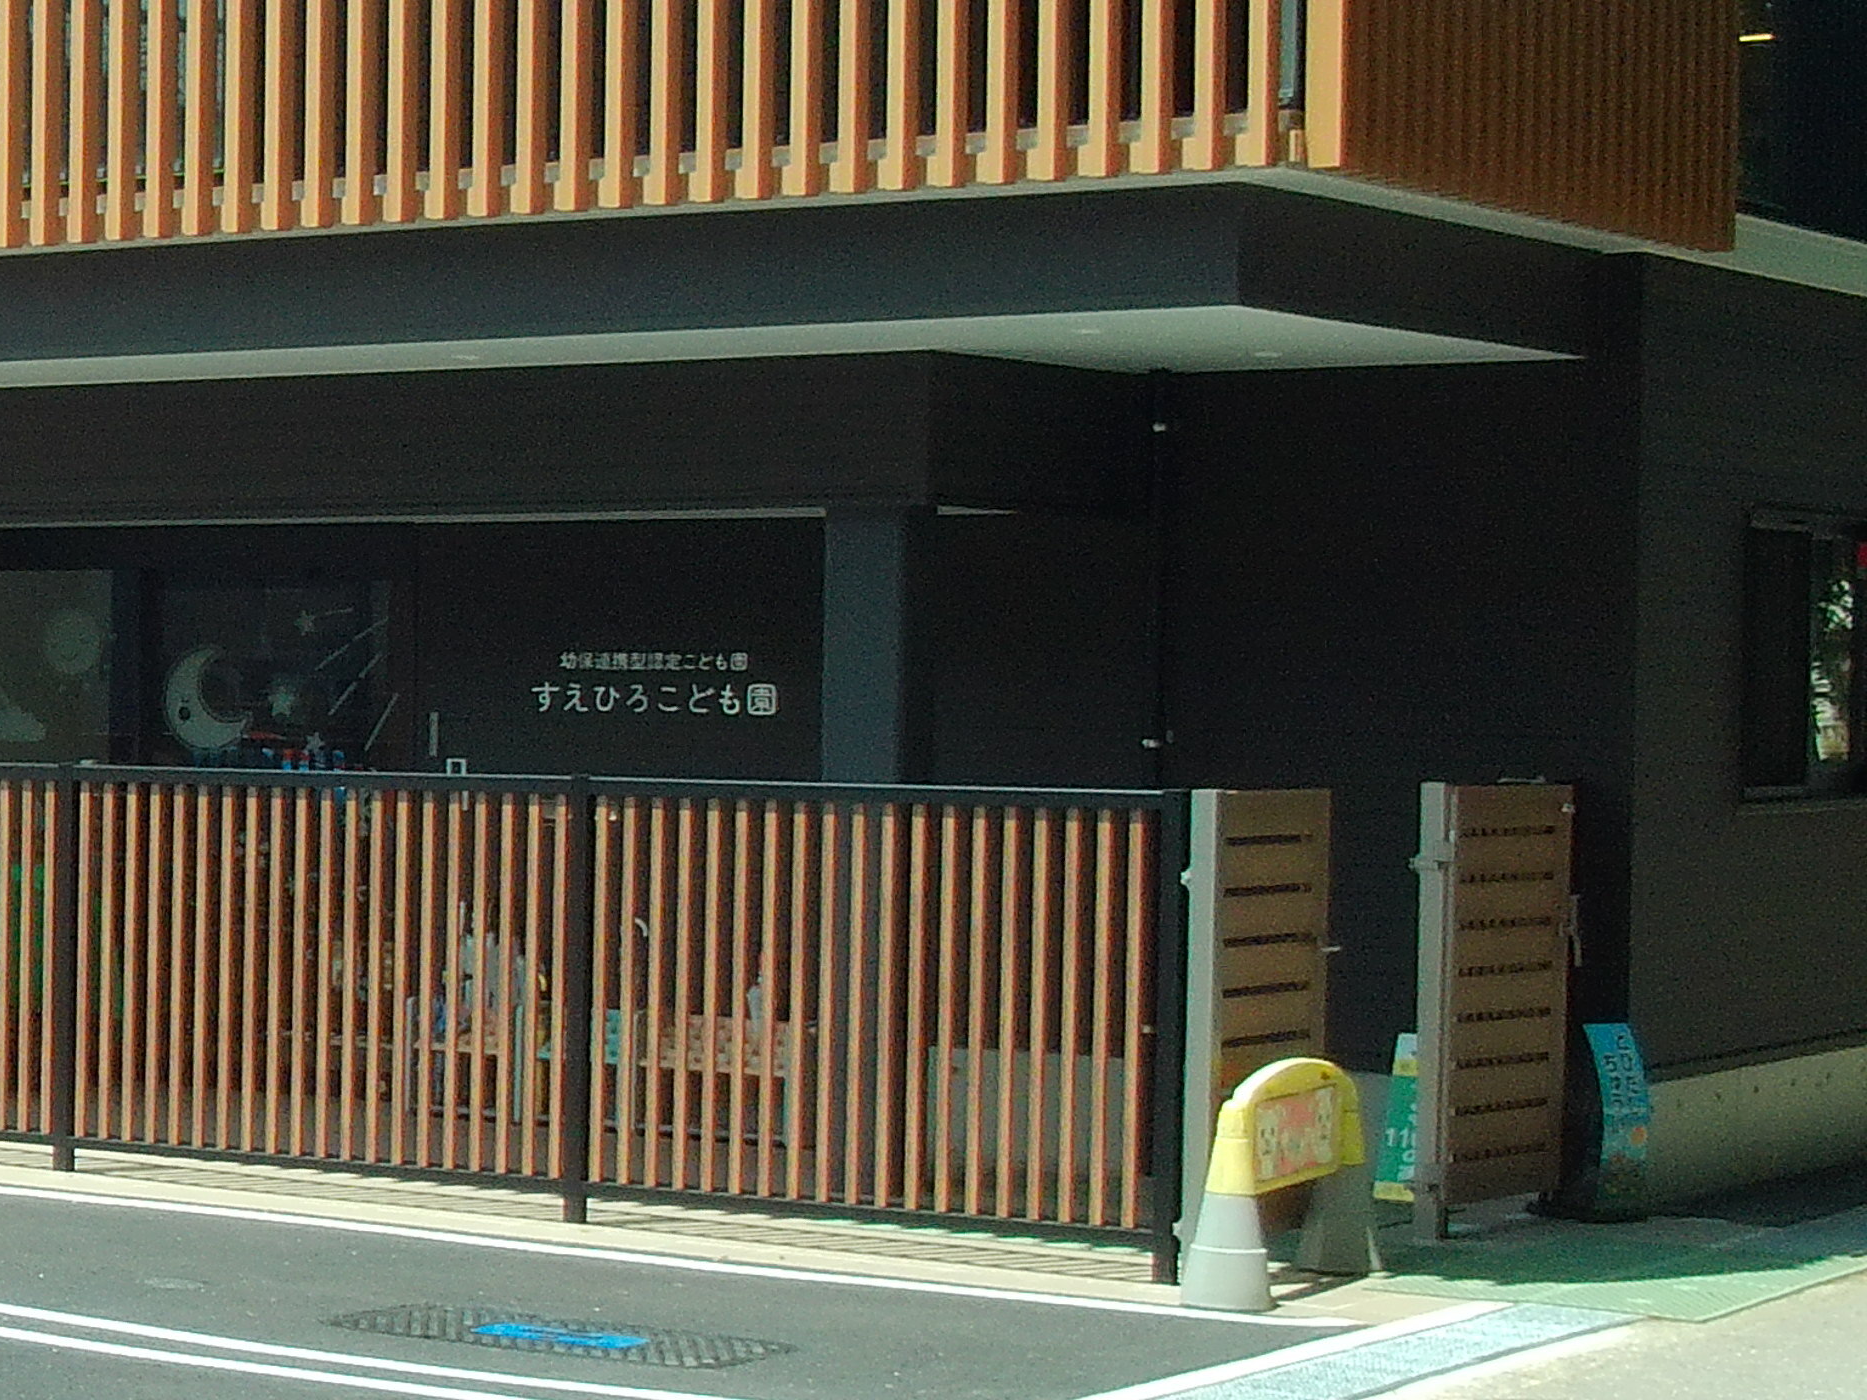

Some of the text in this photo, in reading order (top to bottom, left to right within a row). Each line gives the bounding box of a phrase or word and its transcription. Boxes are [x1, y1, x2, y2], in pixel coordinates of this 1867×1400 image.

[558, 651, 750, 672] 幼保連携型認定こども園
[530, 682, 779, 717] すえひろこども園
